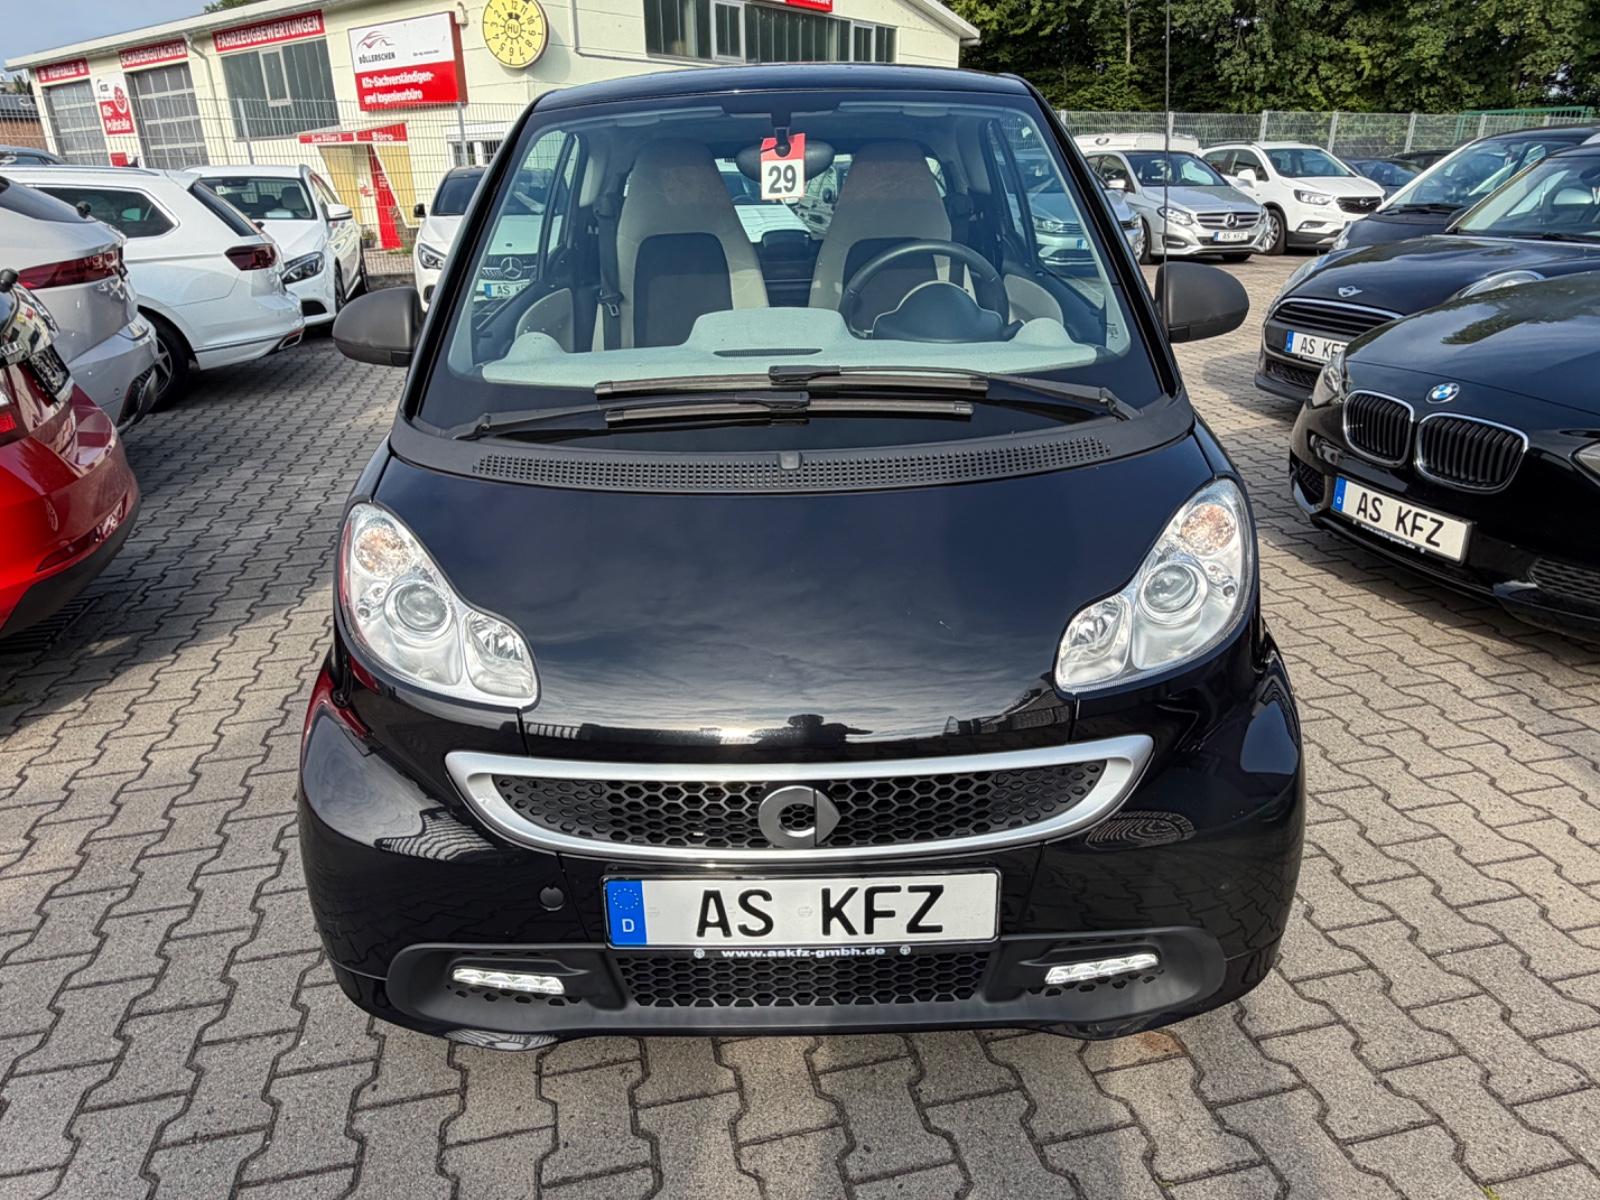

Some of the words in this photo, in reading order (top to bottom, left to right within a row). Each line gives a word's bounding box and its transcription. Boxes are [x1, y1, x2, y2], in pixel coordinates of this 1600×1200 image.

[216, 15, 321, 48] FAHRZEUGBEWERTUNGEN
[507, 24, 519, 34] HU
[121, 42, 187, 66] SCHADENGUTACHTEN
[362, 70, 434, 88] Kfz-Sachverständigen-
[372, 131, 394, 141] Büro
[768, 164, 797, 193] 29
[497, 285, 511, 295] AS
[1300, 337, 1316, 354] AS
[1322, 341, 1347, 359] KF
[1356, 491, 1383, 523] AS
[1395, 505, 1444, 547] KFZ
[696, 889, 774, 938] AS
[821, 884, 944, 936] KFZ
[622, 918, 635, 932] D
[722, 947, 886, 959] www.askfz-gmbh.de
